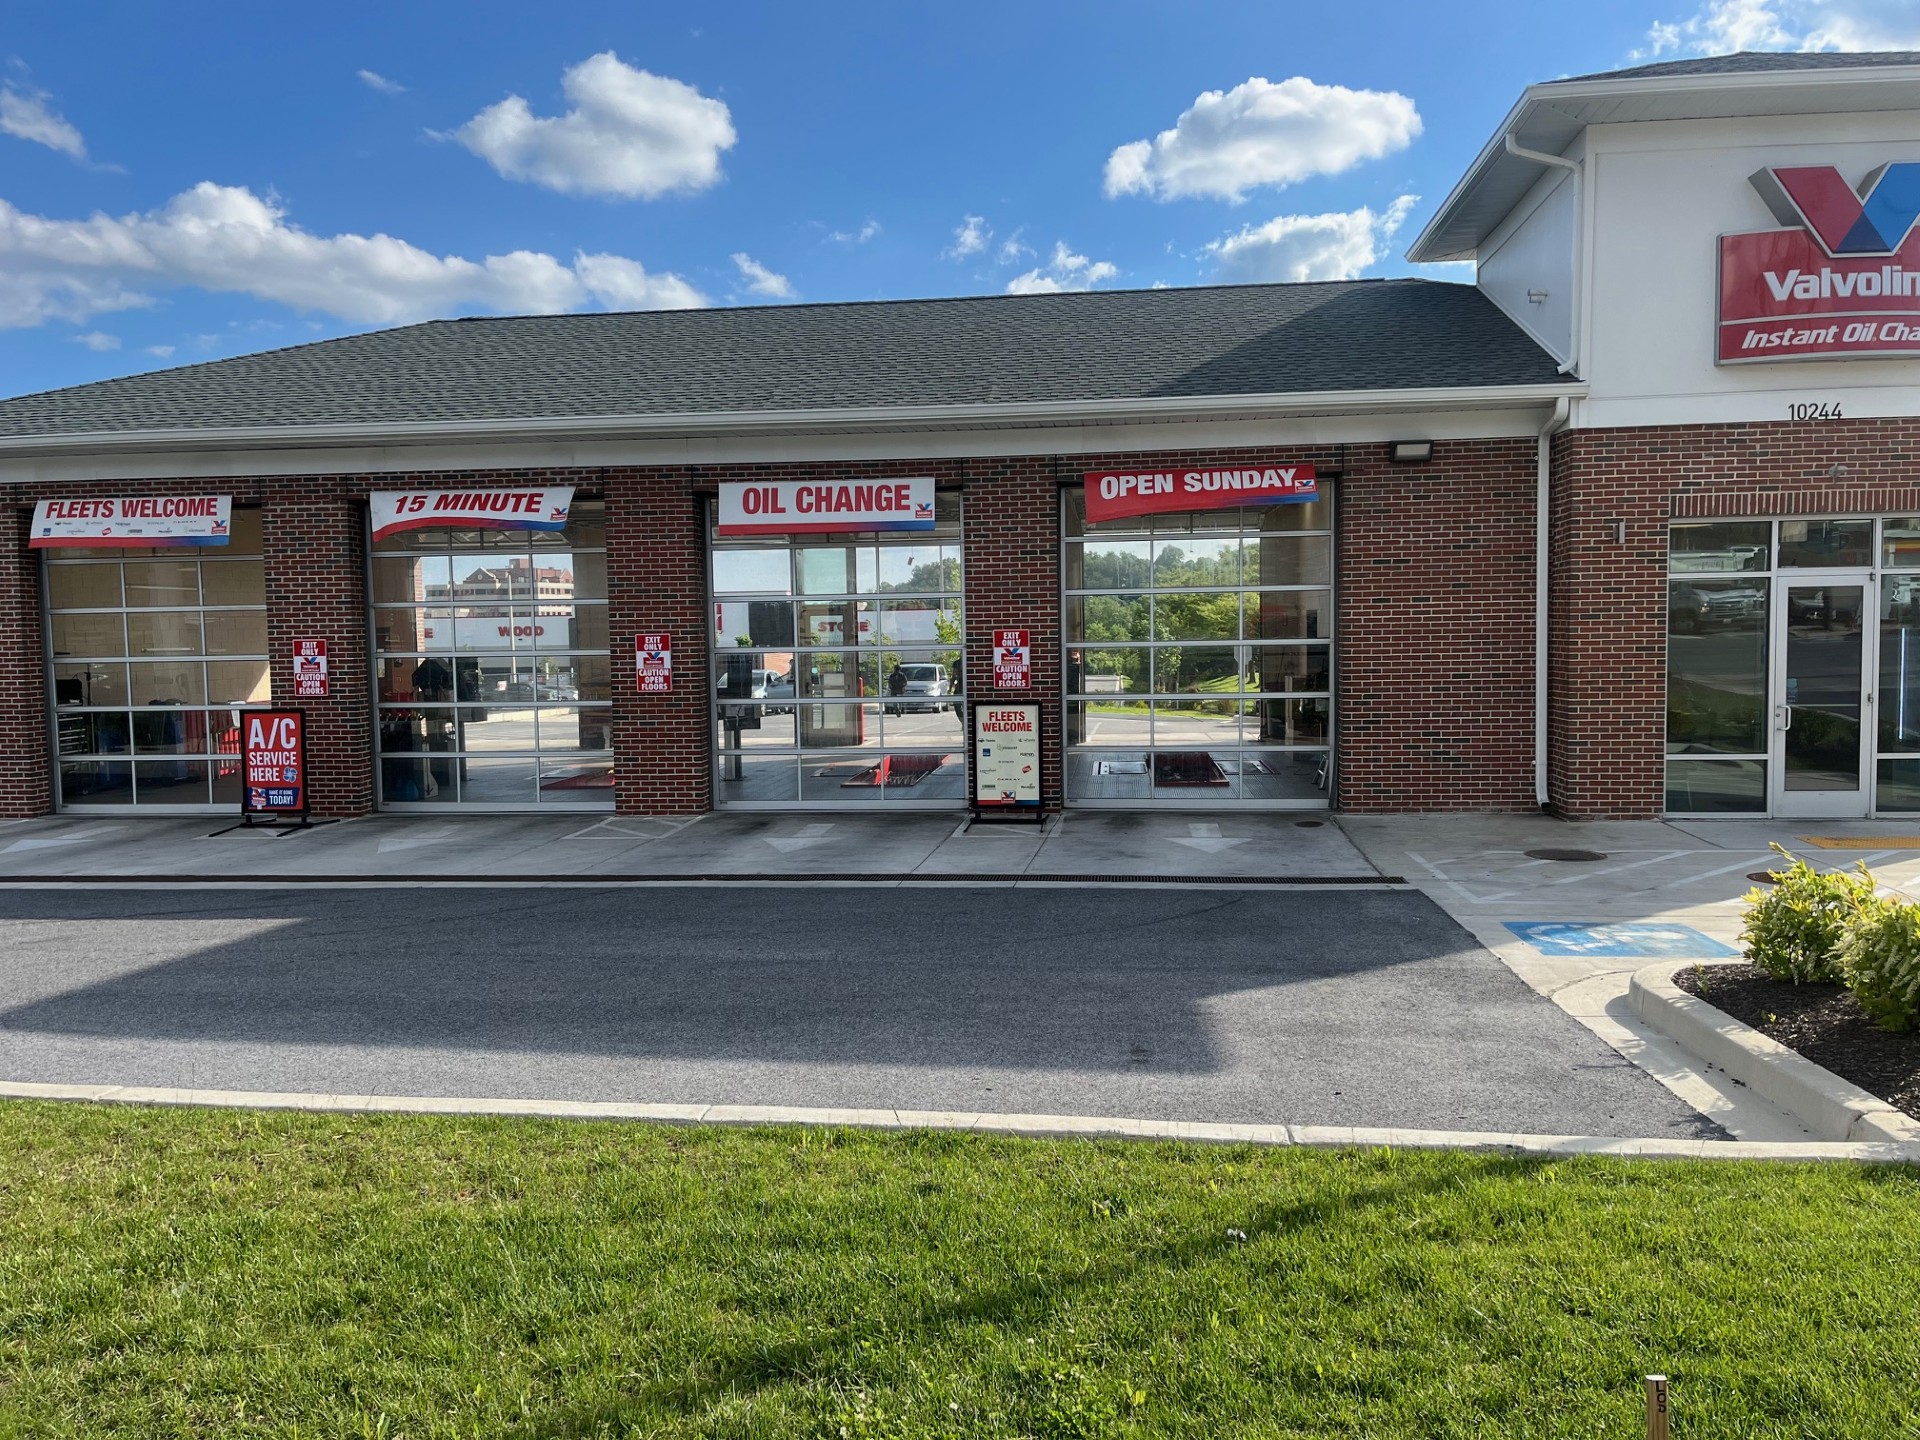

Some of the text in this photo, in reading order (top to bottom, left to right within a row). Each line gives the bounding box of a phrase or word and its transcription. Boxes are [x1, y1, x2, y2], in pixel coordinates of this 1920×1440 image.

[1741, 328, 1839, 349] Instant
[1842, 323, 1877, 343] Oil
[1788, 403, 1843, 421] 10244
[1100, 468, 1297, 500] OPEN SUNDAY
[395, 492, 544, 514] 15 MINUTE
[742, 484, 911, 514] OIL CHANGE
[45, 497, 218, 519] FLEETS WELCOME
[498, 626, 544, 637] WOOD
[818, 621, 869, 632] STOE
[644, 676, 664, 684] OPEN
[1002, 672, 1022, 680] OPEN
[302, 680, 320, 688] OPEN
[299, 687, 325, 695] FLOORS
[988, 711, 1025, 721] FLEETS
[248, 718, 296, 749] A/C
[982, 722, 1032, 732] WELCOME
[249, 751, 297, 766] SERVICE
[250, 767, 280, 782] HERE
[269, 796, 294, 805] TODAY!
